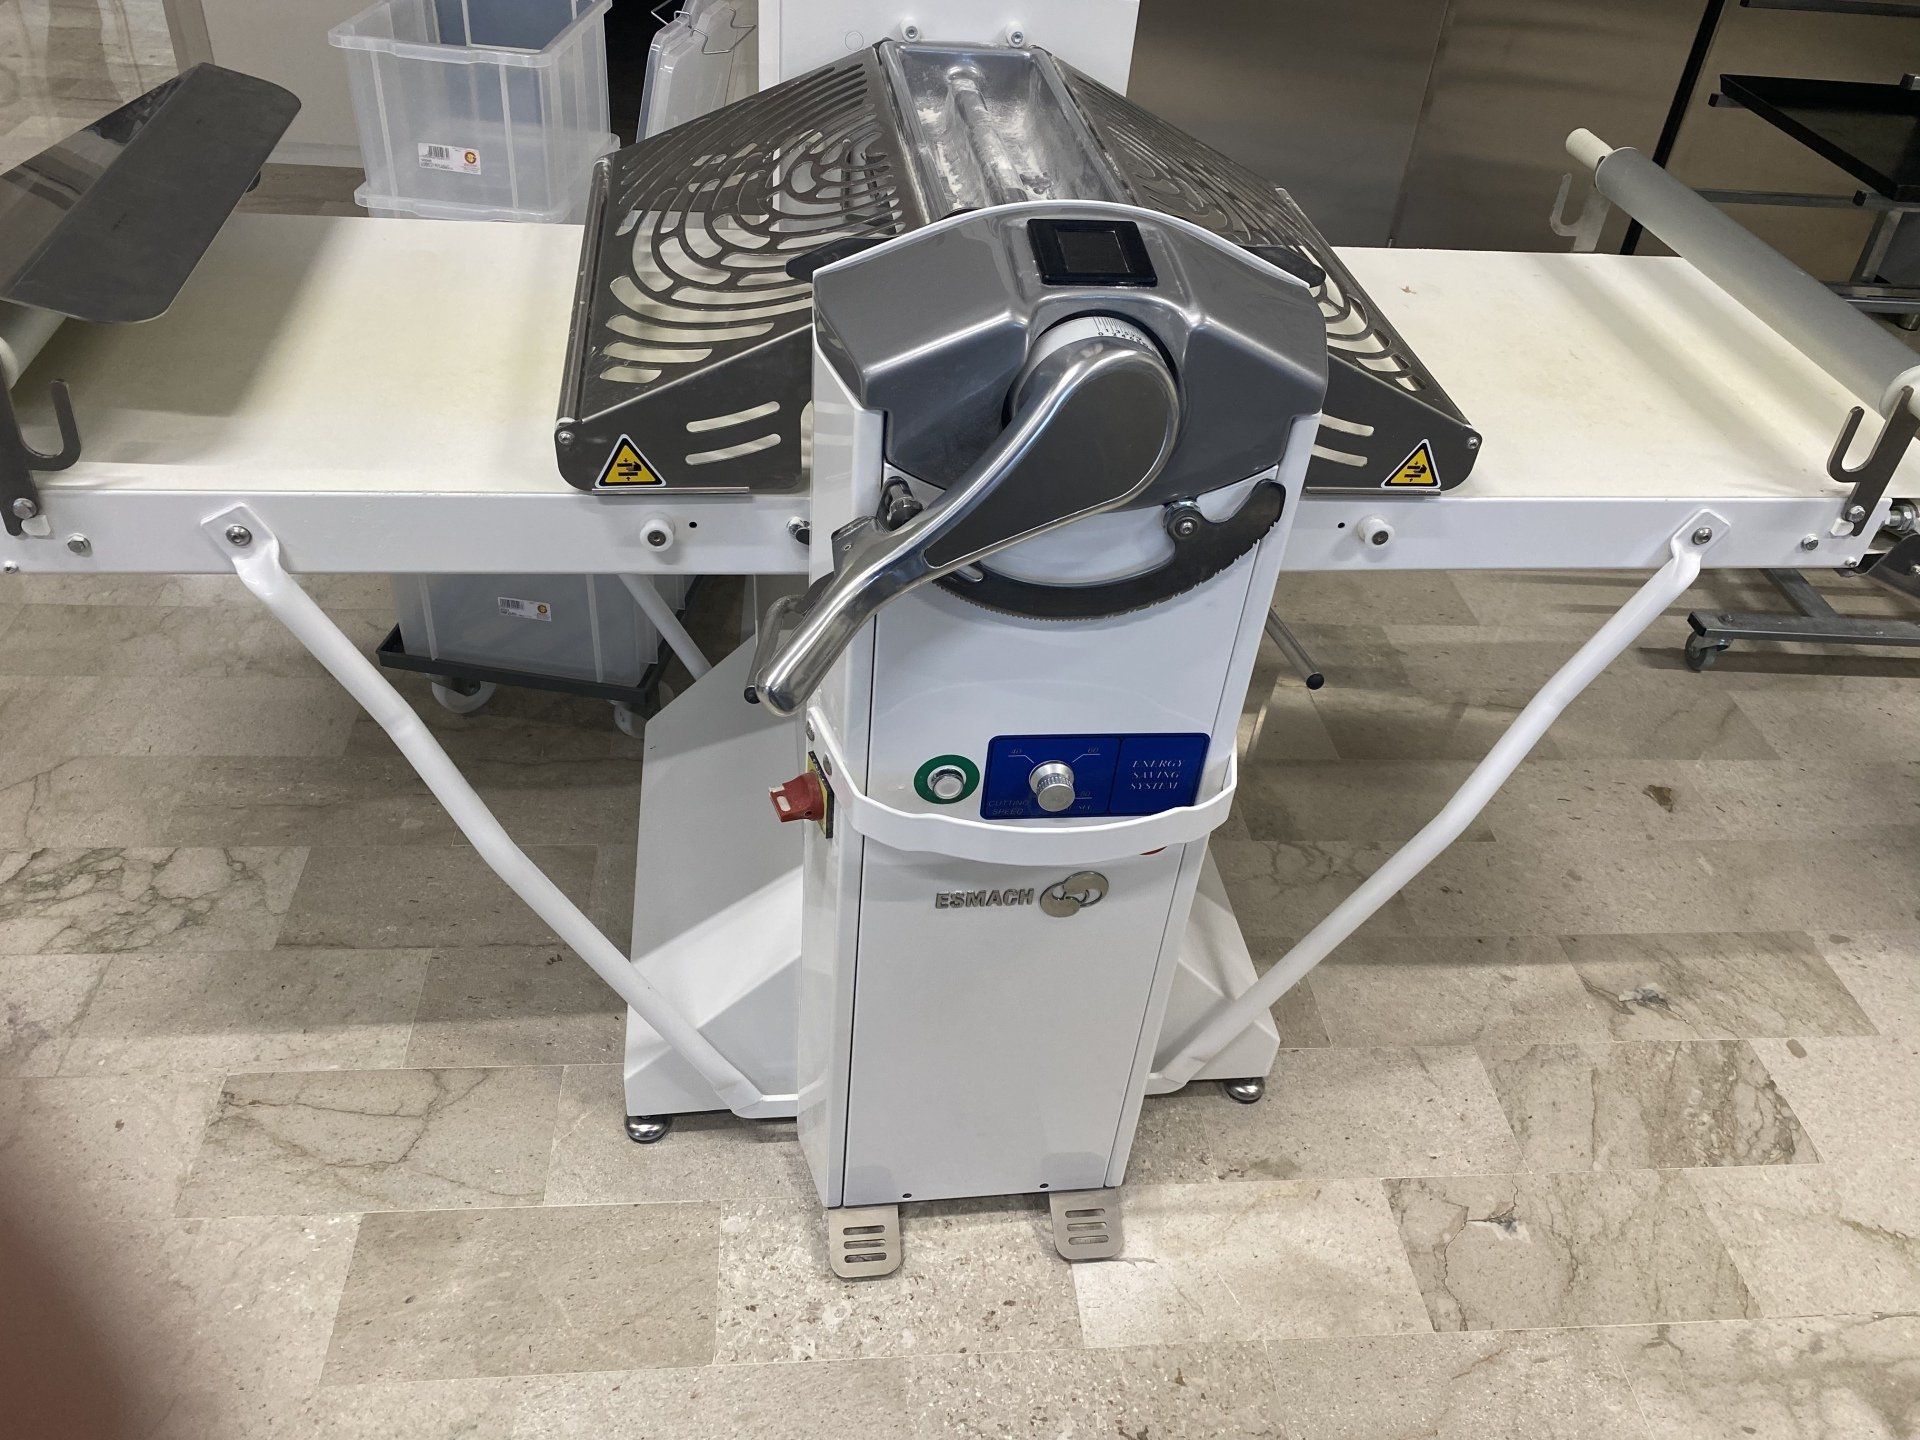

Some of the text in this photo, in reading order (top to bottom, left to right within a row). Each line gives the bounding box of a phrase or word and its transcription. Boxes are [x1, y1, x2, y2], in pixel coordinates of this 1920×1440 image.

[1132, 760, 1183, 768] ENERGY
[1132, 771, 1180, 779] SAVING
[1130, 782, 1178, 790] SYSTEM
[992, 808, 1024, 816] SPEED
[935, 887, 1035, 909] ESMACH
